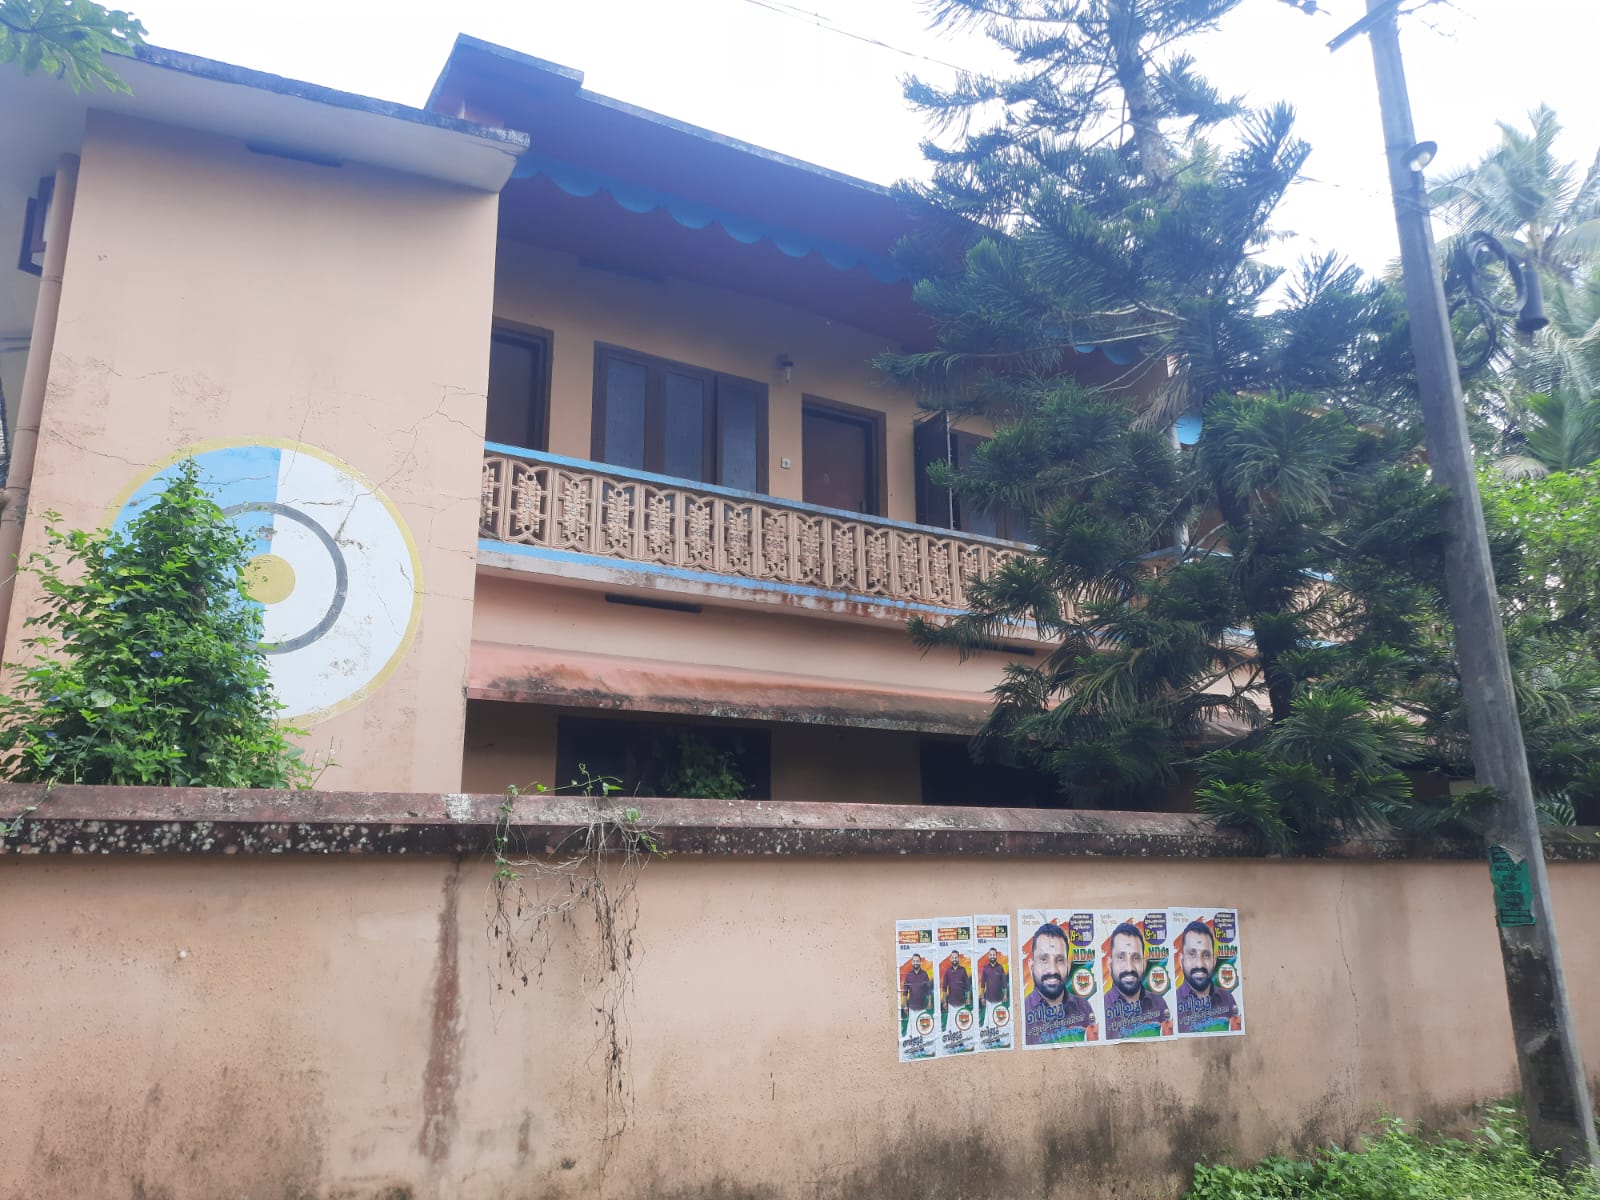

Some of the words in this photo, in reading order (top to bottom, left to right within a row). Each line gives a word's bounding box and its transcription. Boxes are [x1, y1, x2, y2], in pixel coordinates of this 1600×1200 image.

[1072, 949, 1094, 961] NDA
[1148, 947, 1167, 958] NDA
[1217, 945, 1236, 956] NDA
[1026, 1001, 1065, 1024] ബിജു
[1106, 998, 1142, 1019] ബിജു
